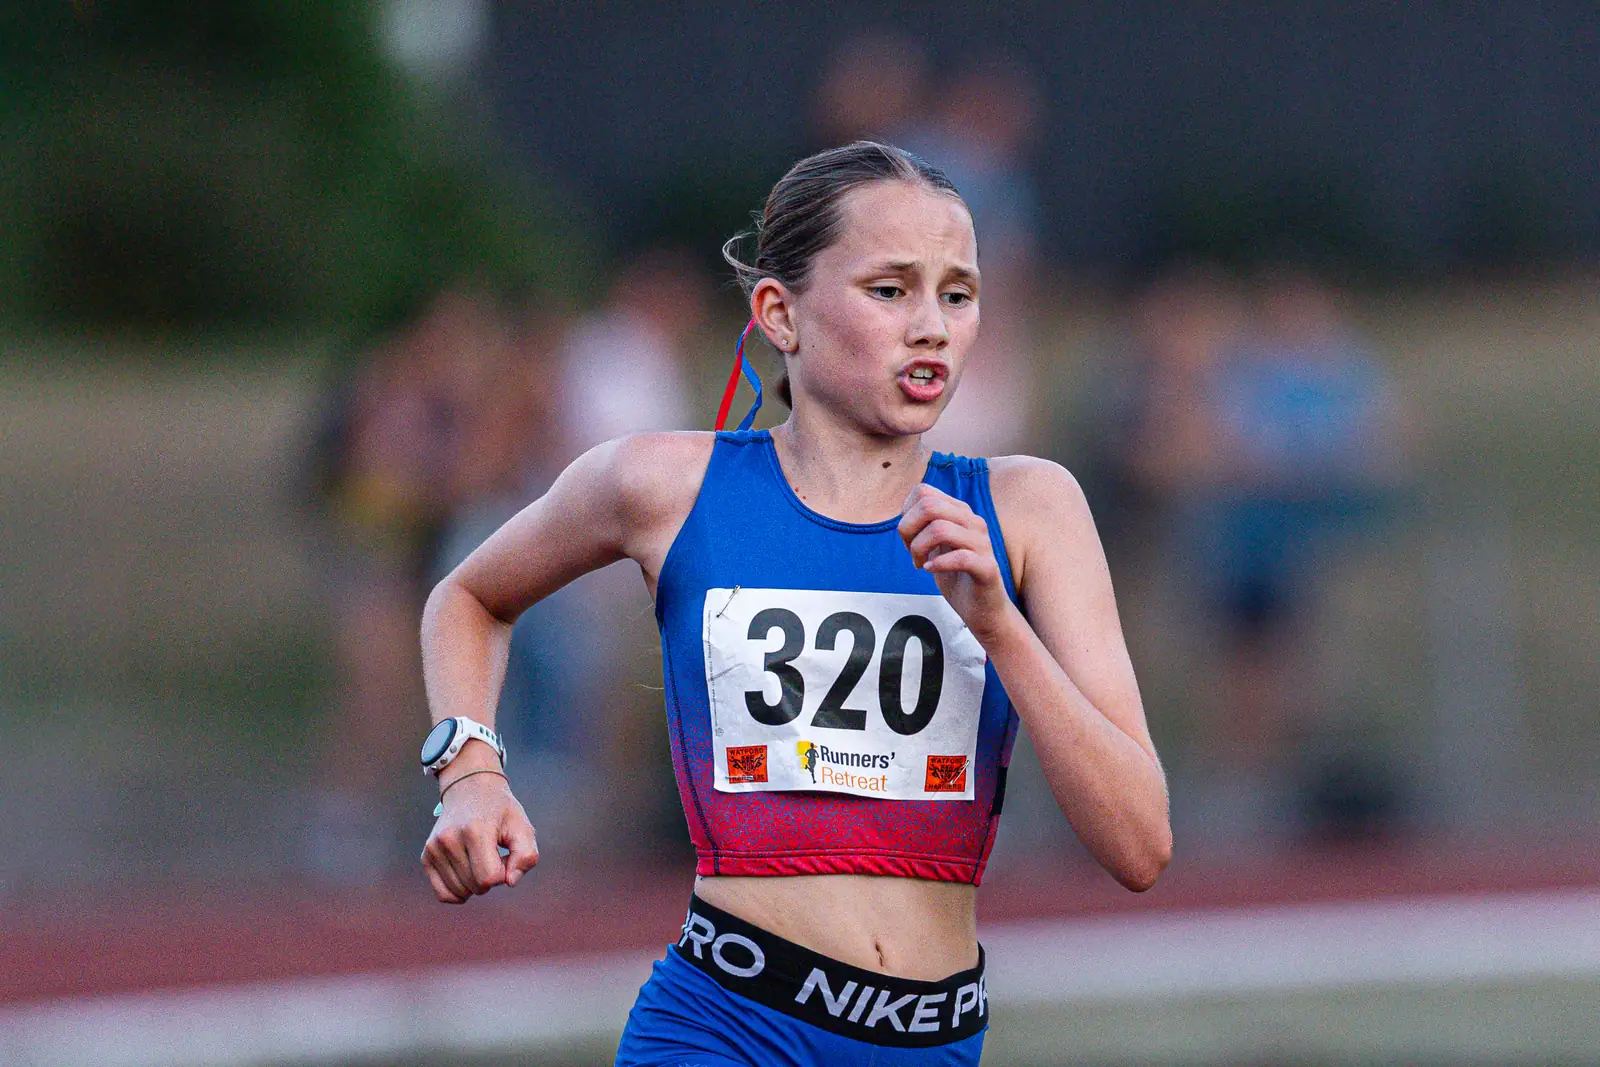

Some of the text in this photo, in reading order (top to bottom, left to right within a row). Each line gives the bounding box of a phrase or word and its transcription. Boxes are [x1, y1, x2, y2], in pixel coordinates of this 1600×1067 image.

[744, 607, 945, 736] 320
[729, 747, 764, 755] WATFORD
[820, 745, 896, 769] Runners'
[821, 766, 888, 792] Retreat
[679, 908, 765, 977] RO
[795, 967, 948, 1033] NIKE
